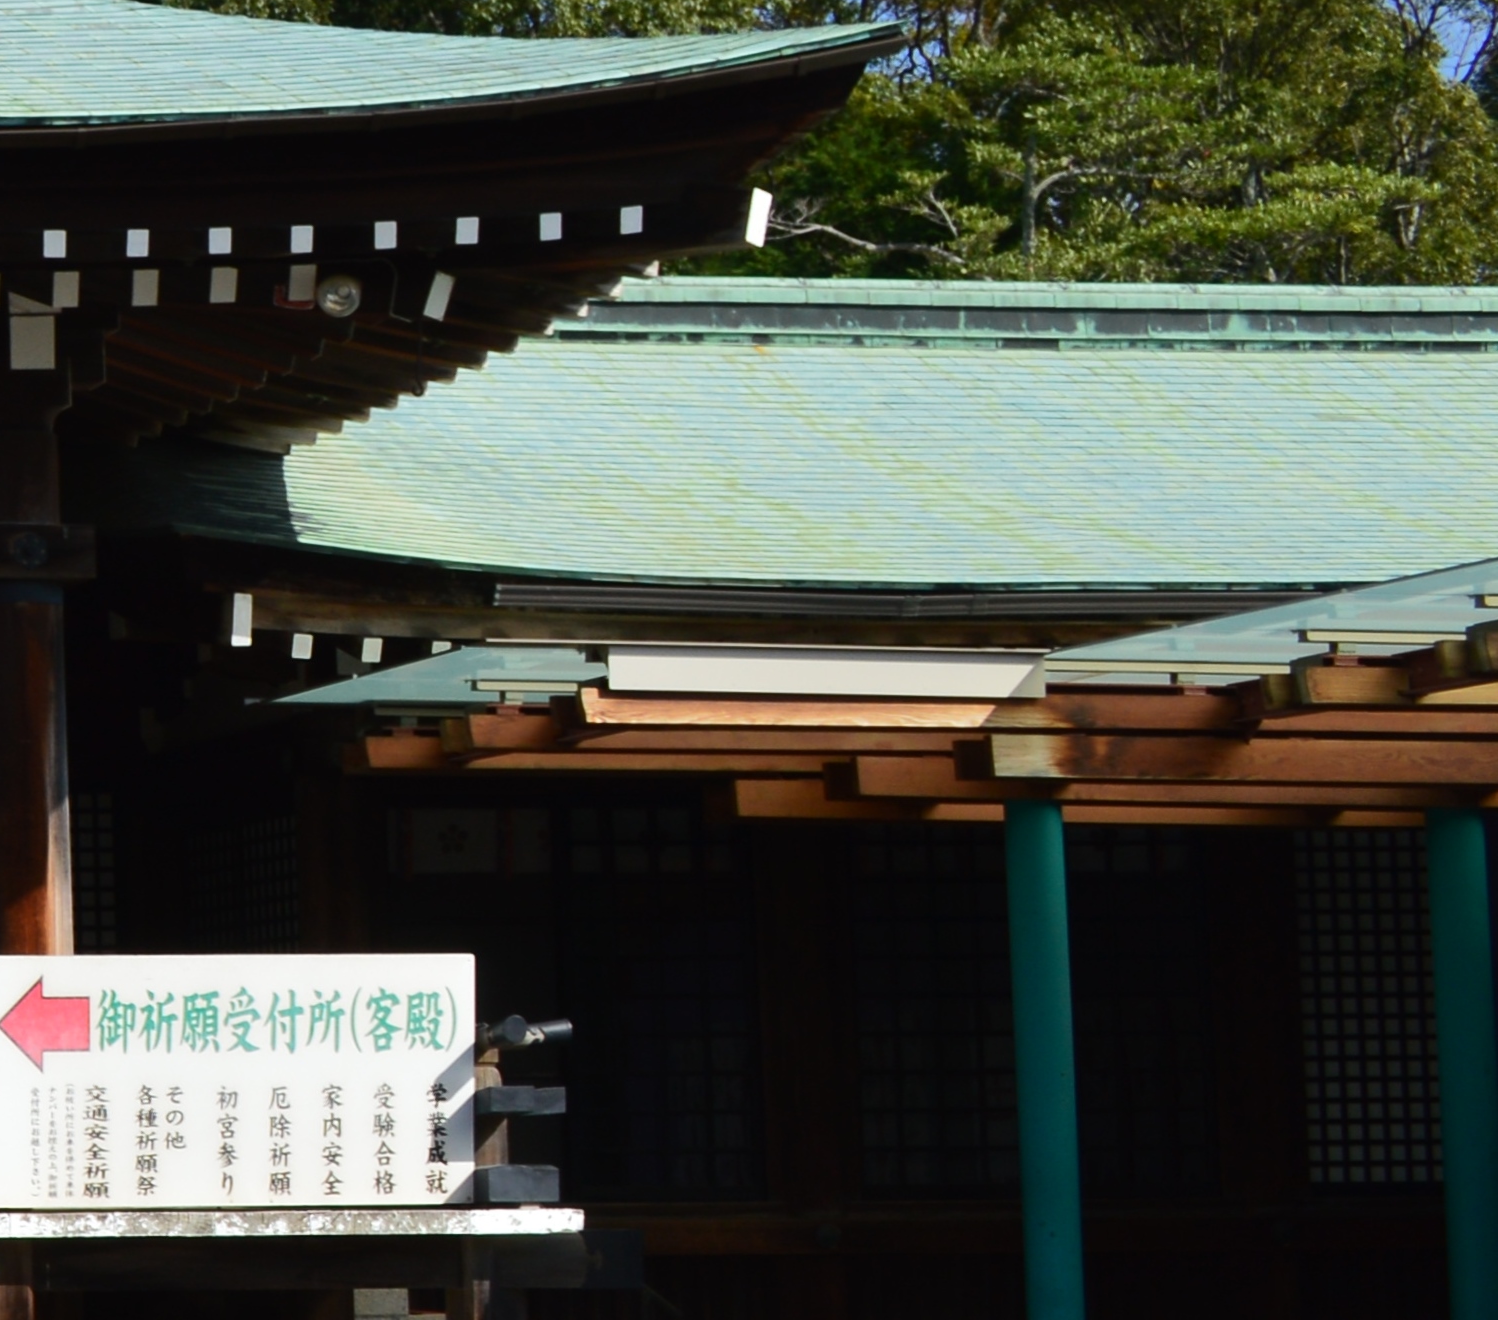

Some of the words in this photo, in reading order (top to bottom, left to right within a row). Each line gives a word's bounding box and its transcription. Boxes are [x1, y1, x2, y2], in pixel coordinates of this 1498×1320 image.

[96, 986, 457, 1054] 御祈願受付所(客殿)
[83, 1085, 110, 1198] 交通安全祈願
[135, 1084, 158, 1196] 各種祈願祭
[164, 1086, 187, 1149] その他
[216, 1085, 239, 1196] 初宮参り
[269, 1086, 291, 1196] 厄除祈願
[322, 1084, 343, 1196] 家内安全
[372, 1082, 396, 1195] 受験合格
[425, 1082, 448, 1194] 学業成就
